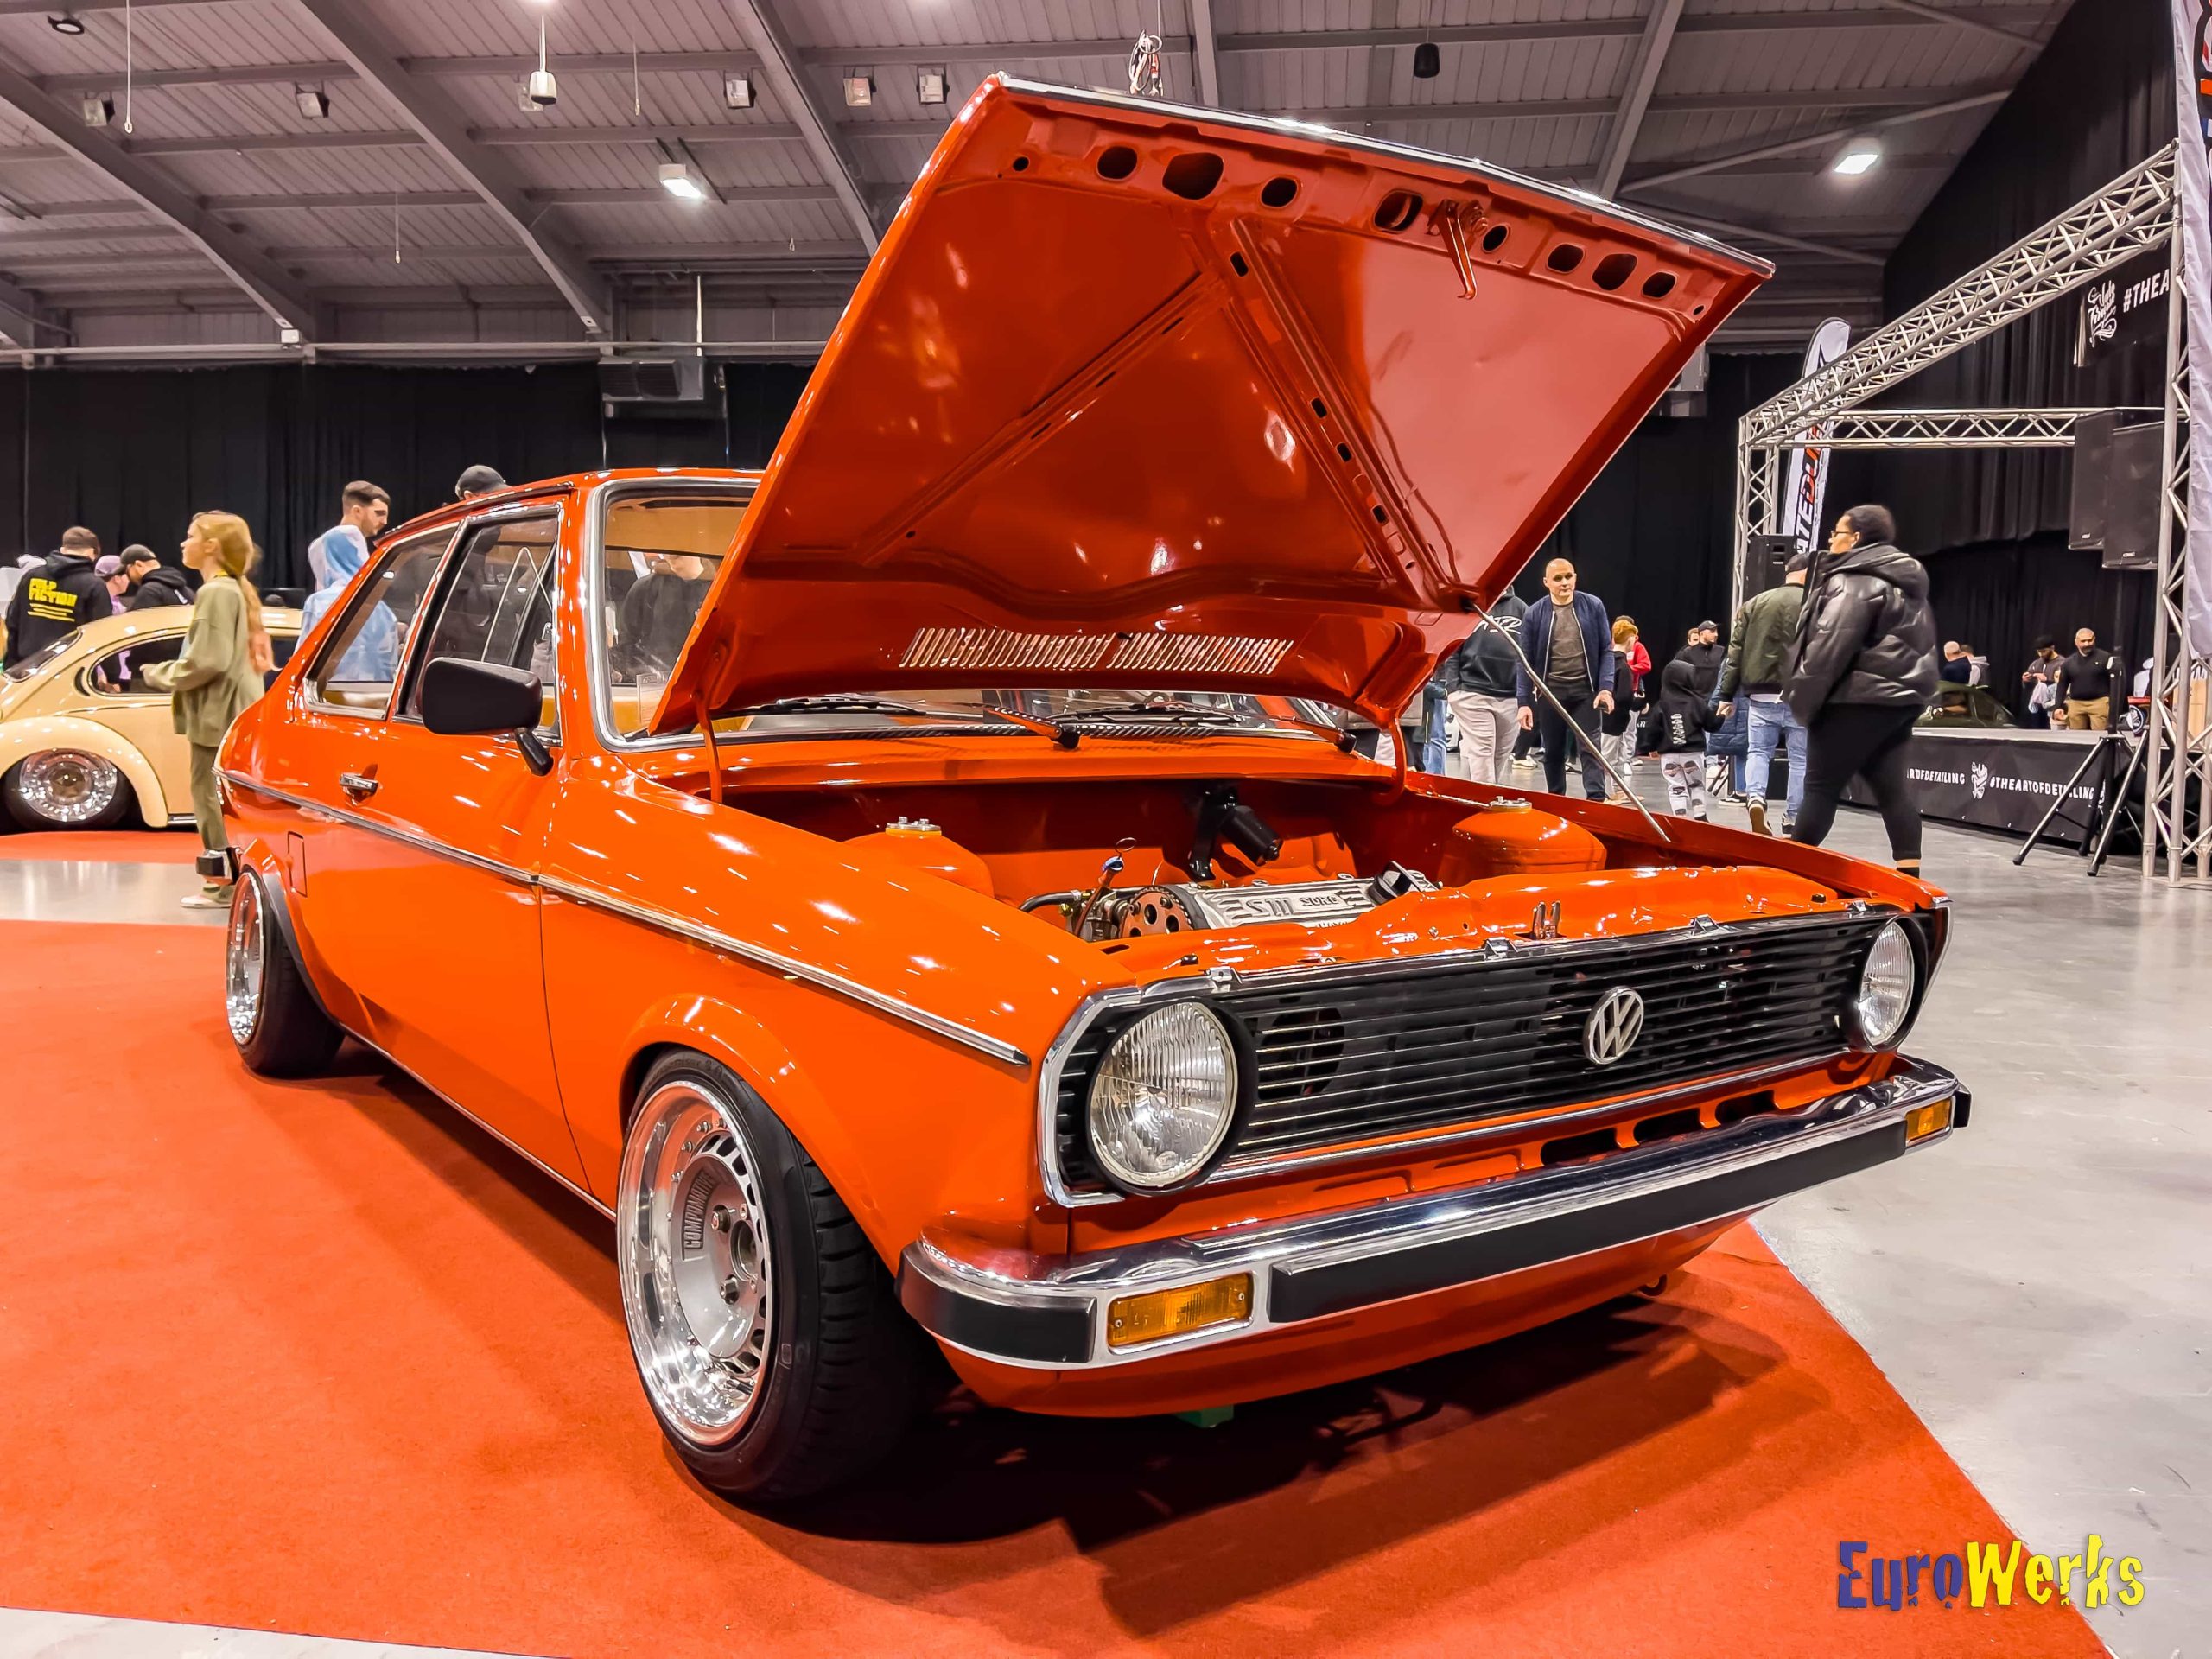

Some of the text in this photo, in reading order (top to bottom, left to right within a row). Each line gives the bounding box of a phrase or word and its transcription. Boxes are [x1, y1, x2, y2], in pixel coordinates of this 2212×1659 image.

[2123, 269, 2170, 313] #THEA
[1906, 768, 1966, 785] RTOFDETAILING
[1989, 775, 2095, 800] #THEARTOFDETLING
